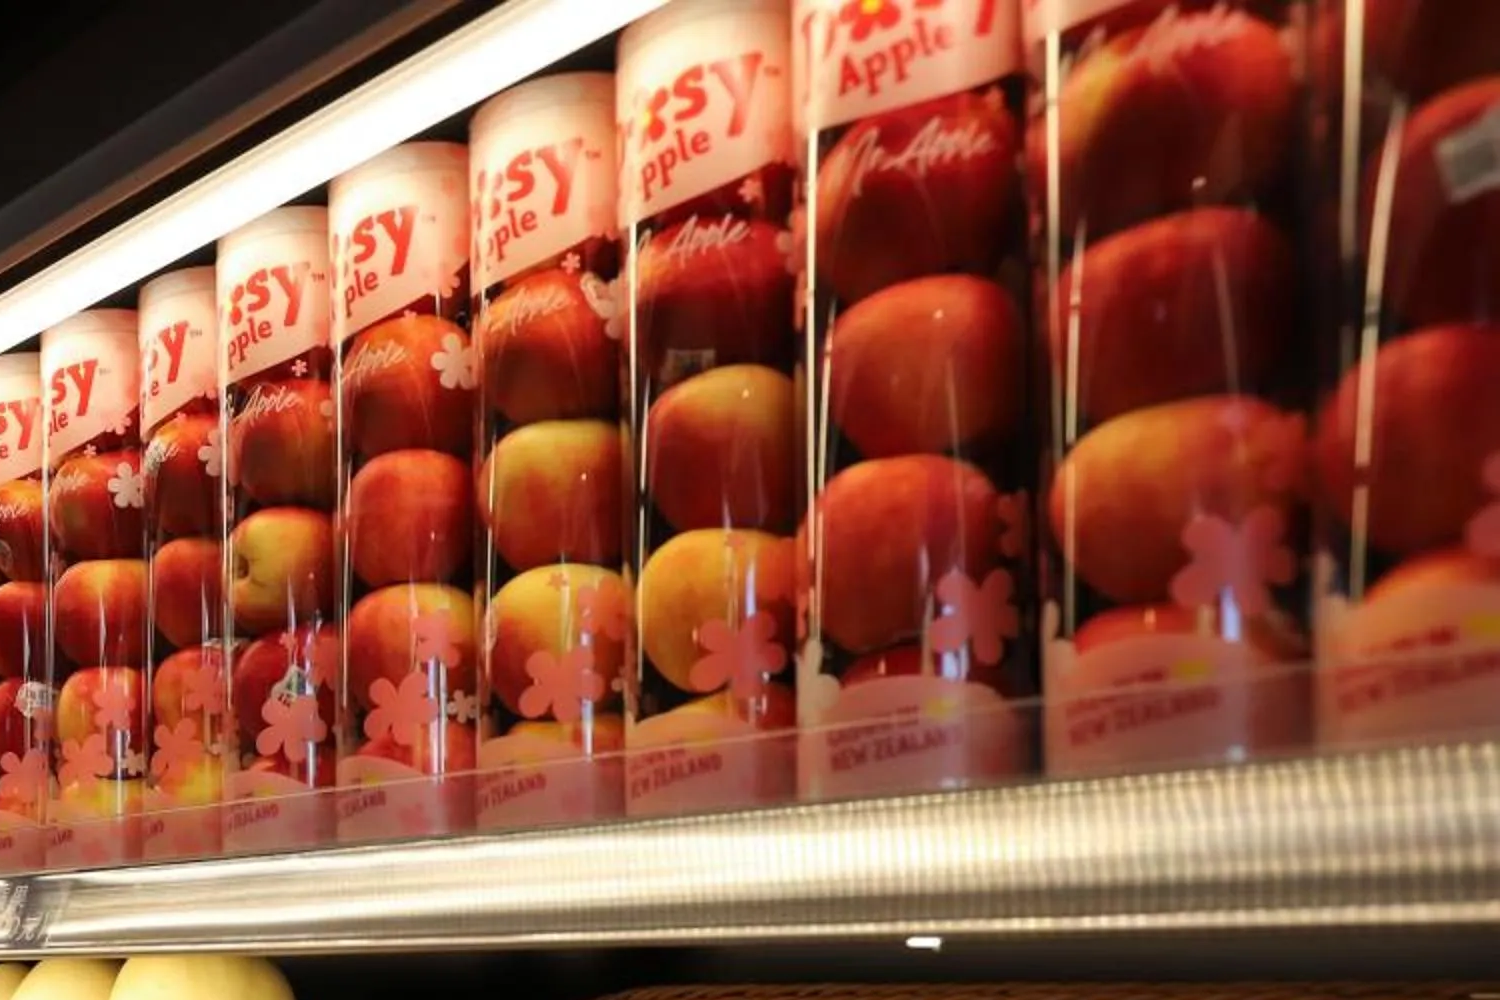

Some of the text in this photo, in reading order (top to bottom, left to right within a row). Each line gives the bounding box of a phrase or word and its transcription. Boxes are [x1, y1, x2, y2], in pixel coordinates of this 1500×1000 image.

[838, 18, 956, 97] Apple
[493, 137, 584, 220] sy
[640, 129, 712, 201] pple
[353, 205, 419, 276] sy
[490, 209, 538, 262] ple
[343, 270, 380, 317] ple
[226, 317, 273, 370] pple
[52, 359, 98, 417] sy
